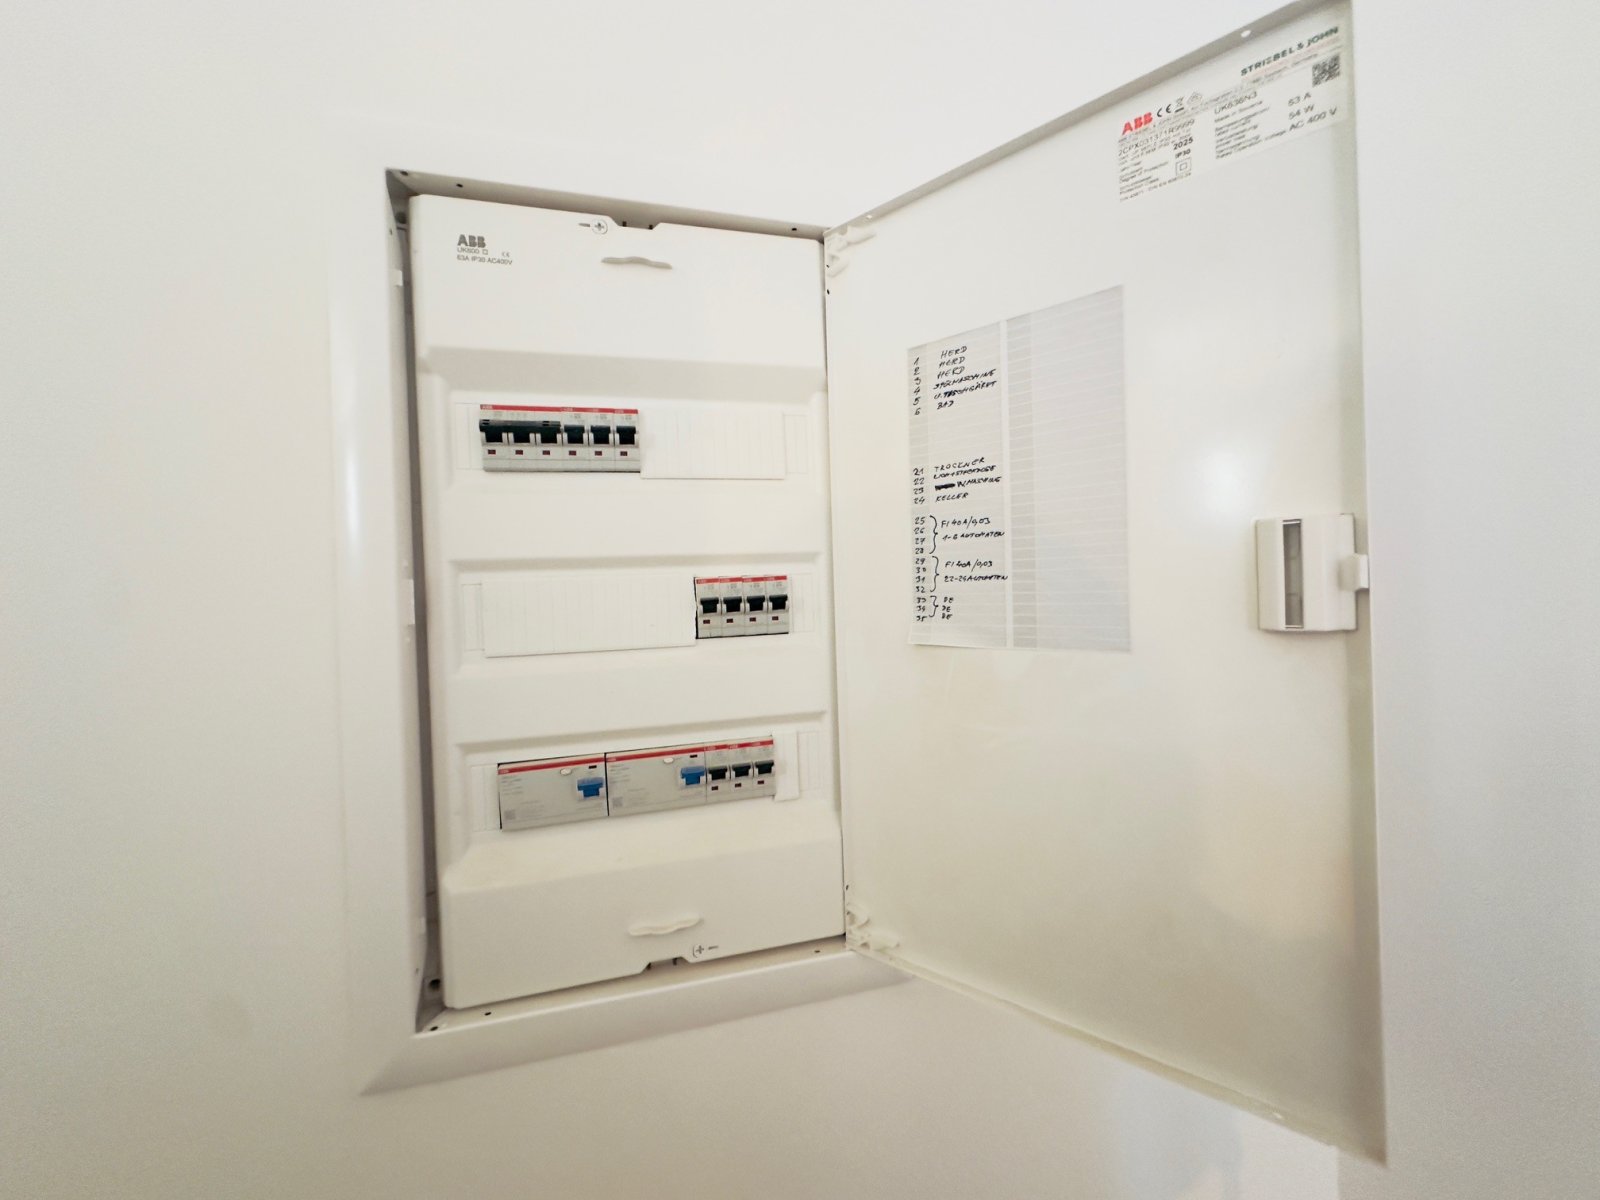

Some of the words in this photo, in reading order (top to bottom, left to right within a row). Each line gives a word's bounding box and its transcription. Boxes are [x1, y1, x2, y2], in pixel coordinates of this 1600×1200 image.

[1241, 48, 1294, 76] STRIEBEL
[1307, 26, 1338, 47] JOHN
[1304, 92, 1311, 100] A
[1304, 104, 1314, 113] W
[1122, 112, 1153, 135] ABB
[1289, 120, 1304, 131] AC
[1307, 112, 1327, 123] 400
[1329, 106, 1337, 116] V
[1173, 136, 1194, 150] 2025
[457, 234, 487, 248] ABB
[914, 356, 920, 366] 1
[940, 345, 968, 360] HERD
[938, 356, 966, 369] HERD
[937, 366, 965, 379] HERD
[914, 386, 920, 396] 4
[913, 396, 921, 406] 5
[914, 407, 921, 416] 6
[936, 400, 954, 410] BAD
[912, 467, 924, 476] 21
[914, 477, 925, 486] 22
[914, 486, 924, 495] 23
[914, 496, 926, 505] 24
[935, 492, 969, 502] KELLER
[914, 516, 926, 525] 25
[914, 526, 926, 535] 26
[914, 547, 924, 555] 28
[915, 557, 926, 566] 29
[916, 575, 926, 583] 31
[916, 586, 926, 594] 32
